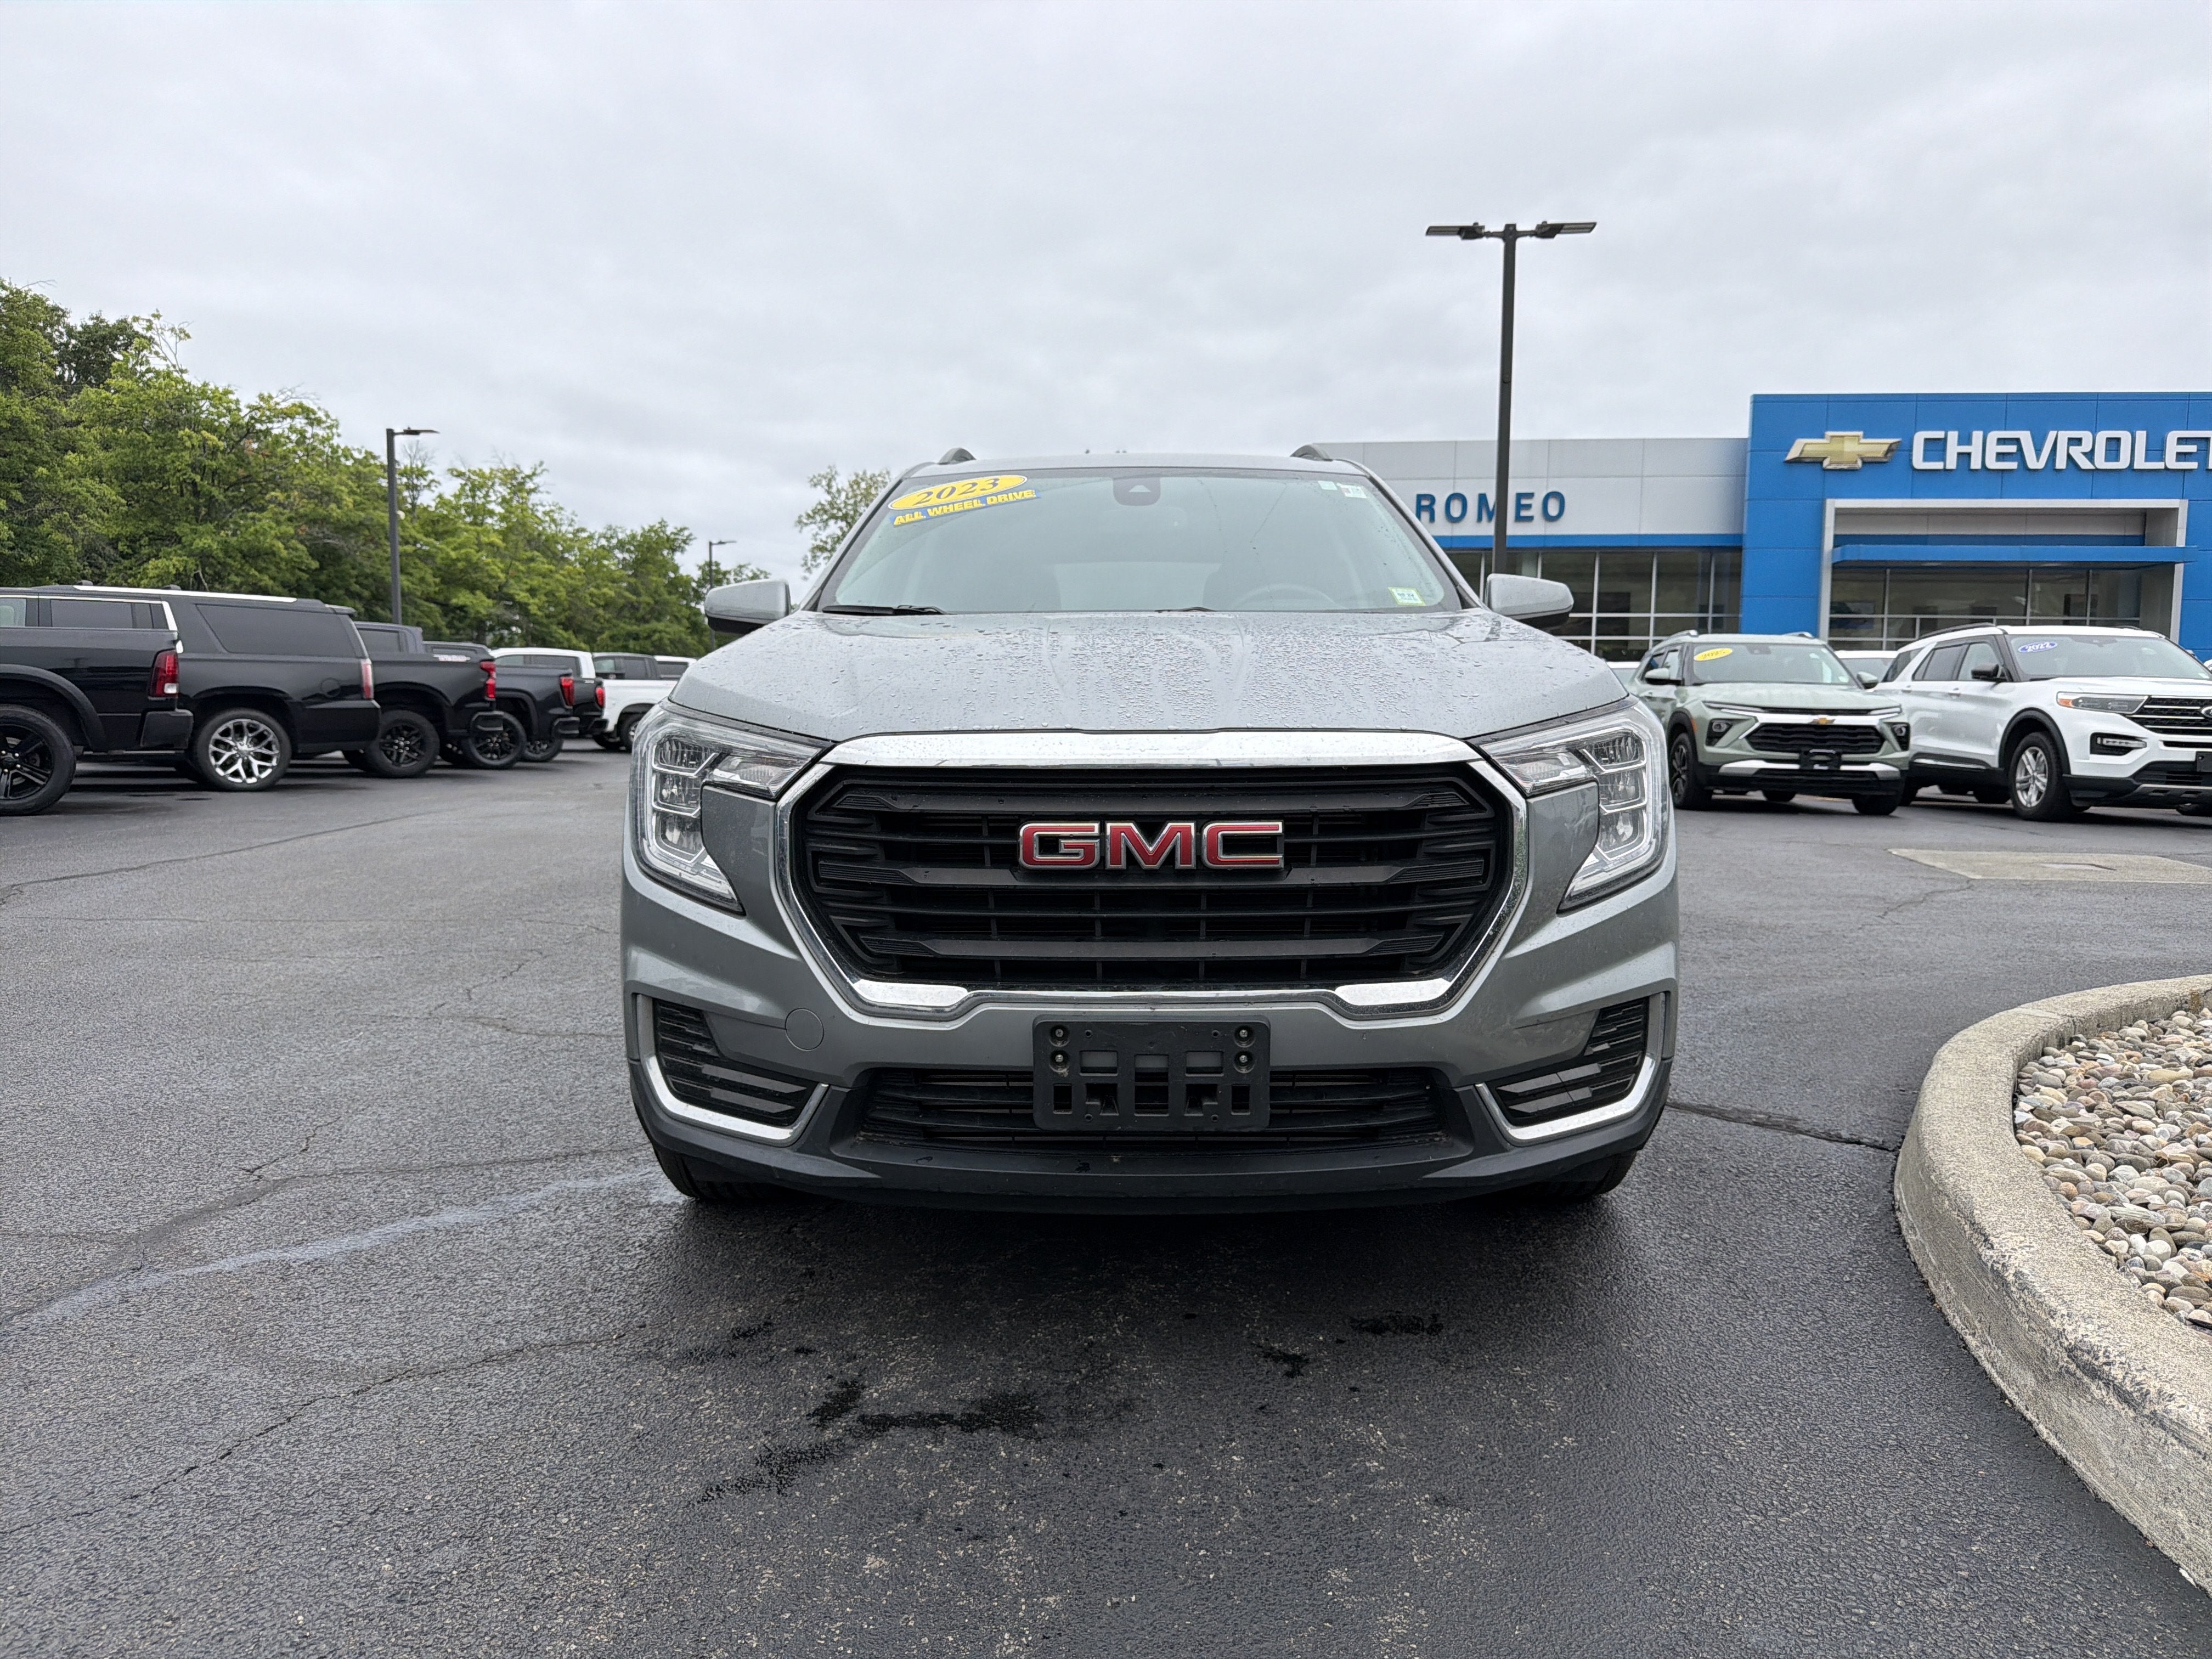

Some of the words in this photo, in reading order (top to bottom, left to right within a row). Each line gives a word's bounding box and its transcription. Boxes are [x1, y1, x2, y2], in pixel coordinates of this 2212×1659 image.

[893, 511, 927, 526] ALL
[927, 499, 986, 517] WHEEL
[986, 489, 1036, 505] DRIVE
[912, 478, 1000, 506] 2023
[1415, 491, 1566, 523] ROMEO
[2025, 642, 2051, 652] 2022
[1018, 821, 1284, 870] GMC
